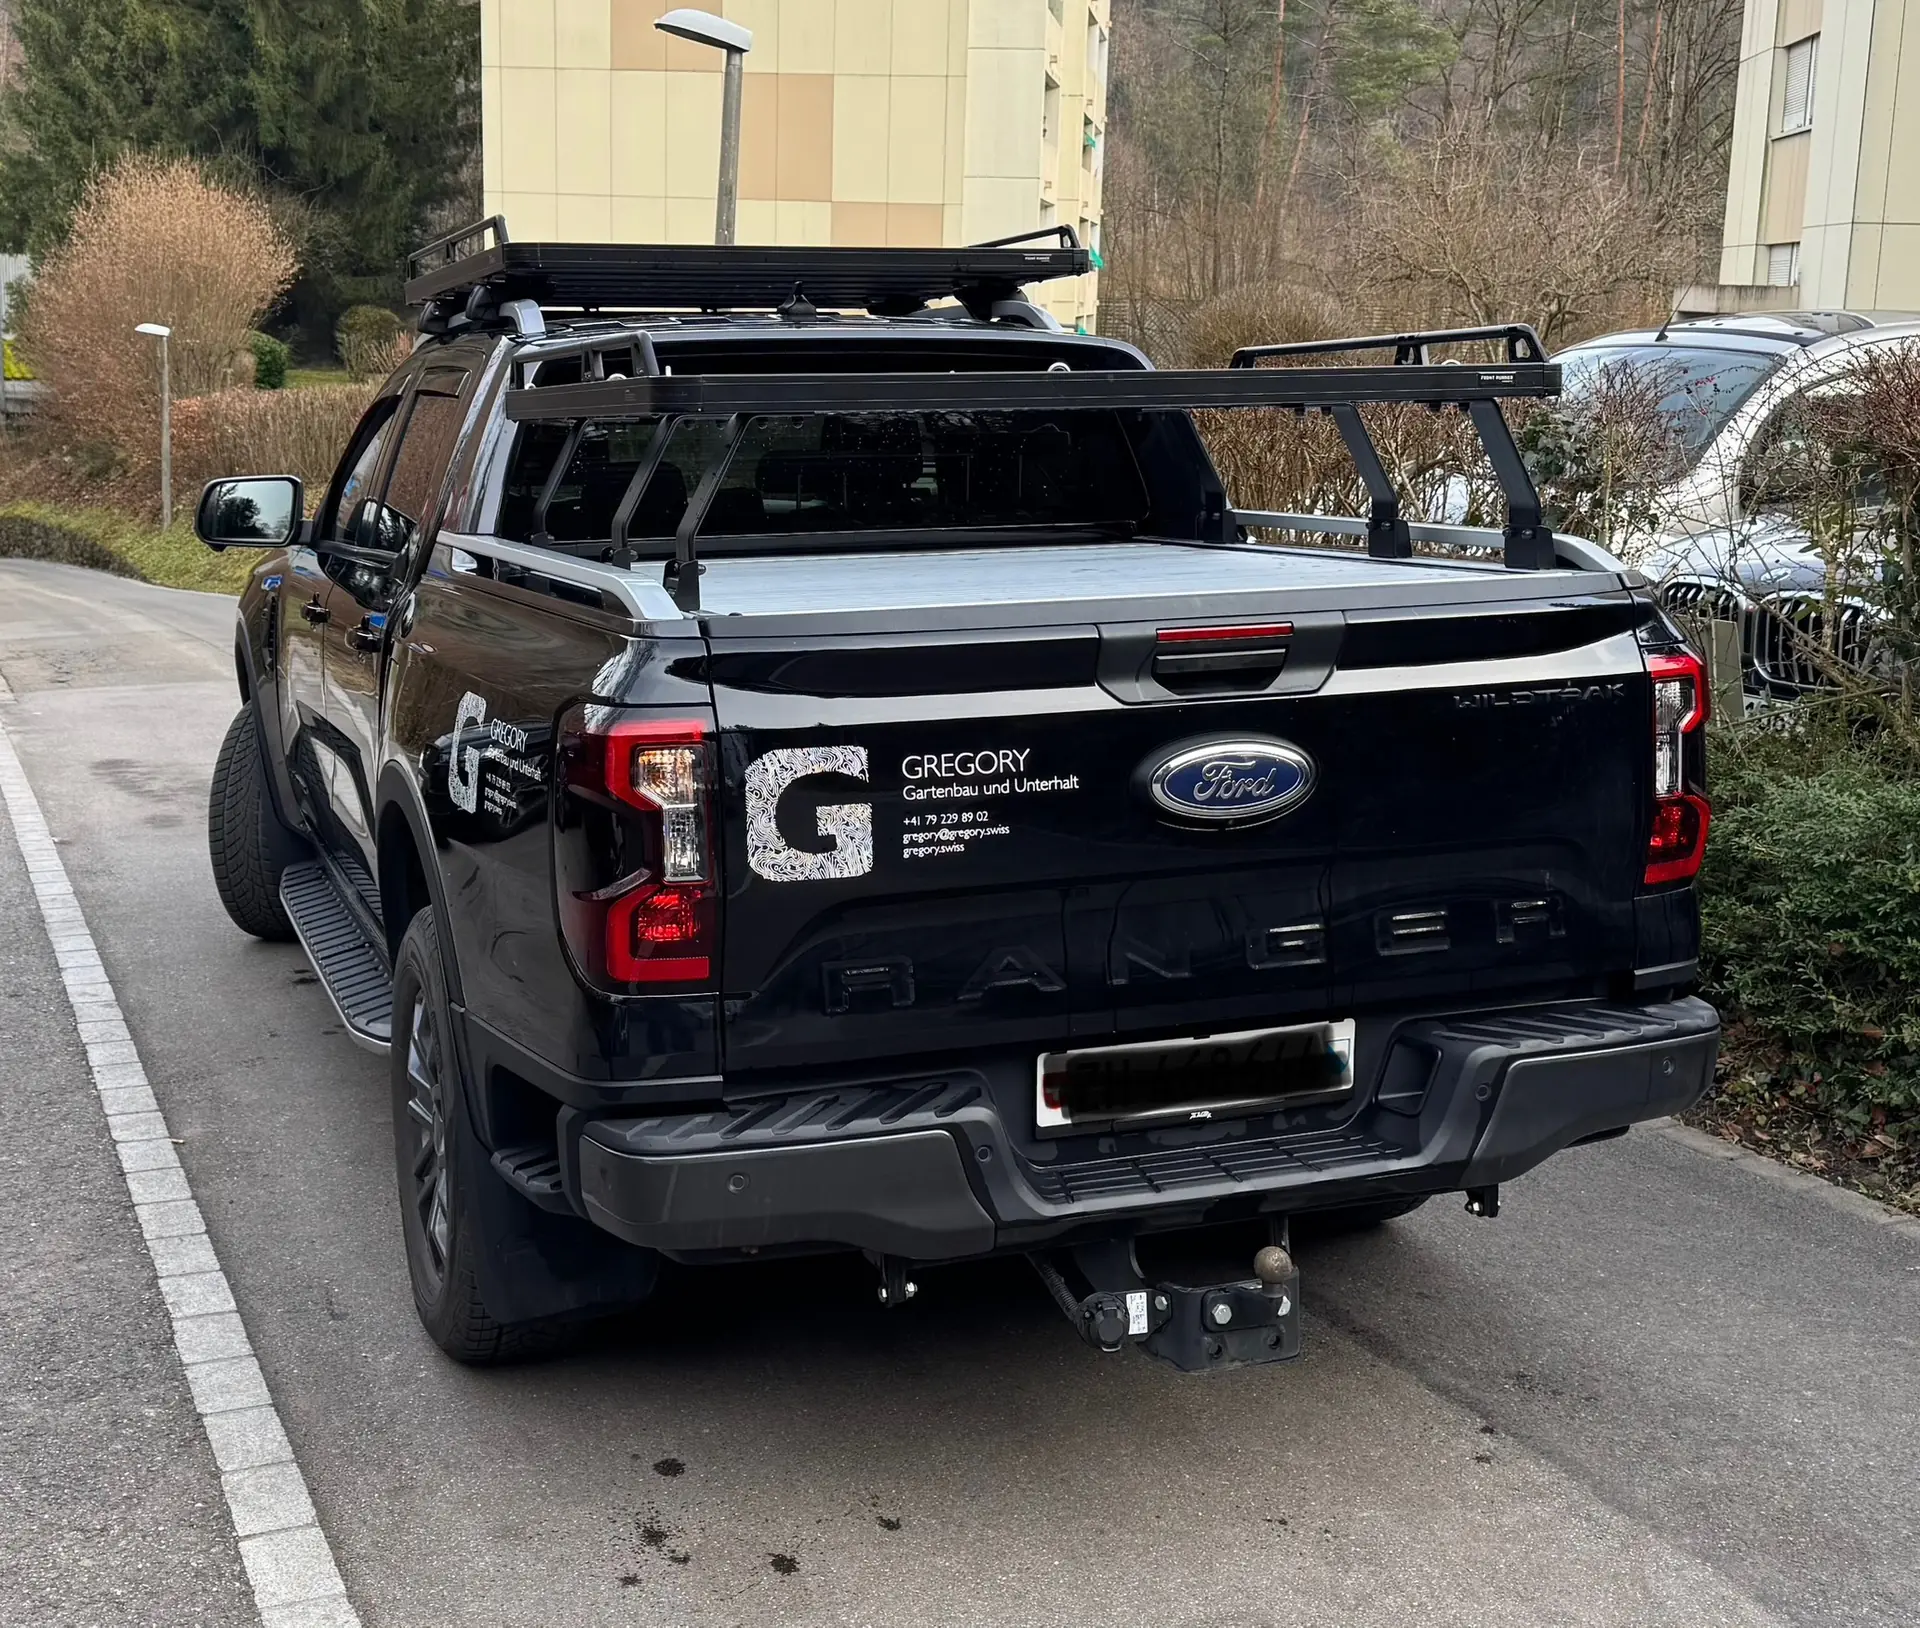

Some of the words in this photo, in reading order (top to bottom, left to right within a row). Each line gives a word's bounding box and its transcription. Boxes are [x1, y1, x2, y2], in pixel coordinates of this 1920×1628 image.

[490, 718, 528, 752] GREGORY
[901, 748, 1031, 779] GREGORY
[902, 782, 979, 801] Gartenbau
[983, 778, 1010, 795] und
[1013, 774, 1079, 793] Unterhalt
[1193, 759, 1277, 801] Ford
[745, 745, 873, 882] G
[903, 815, 921, 826] +41
[924, 814, 938, 826] 79
[940, 813, 959, 825] 229
[961, 811, 974, 823] 89
[976, 810, 989, 822] 02
[902, 824, 1010, 844] gregory@gregory.swiss
[902, 842, 965, 858] gregory.swiss
[822, 894, 1567, 1015] RANGER
